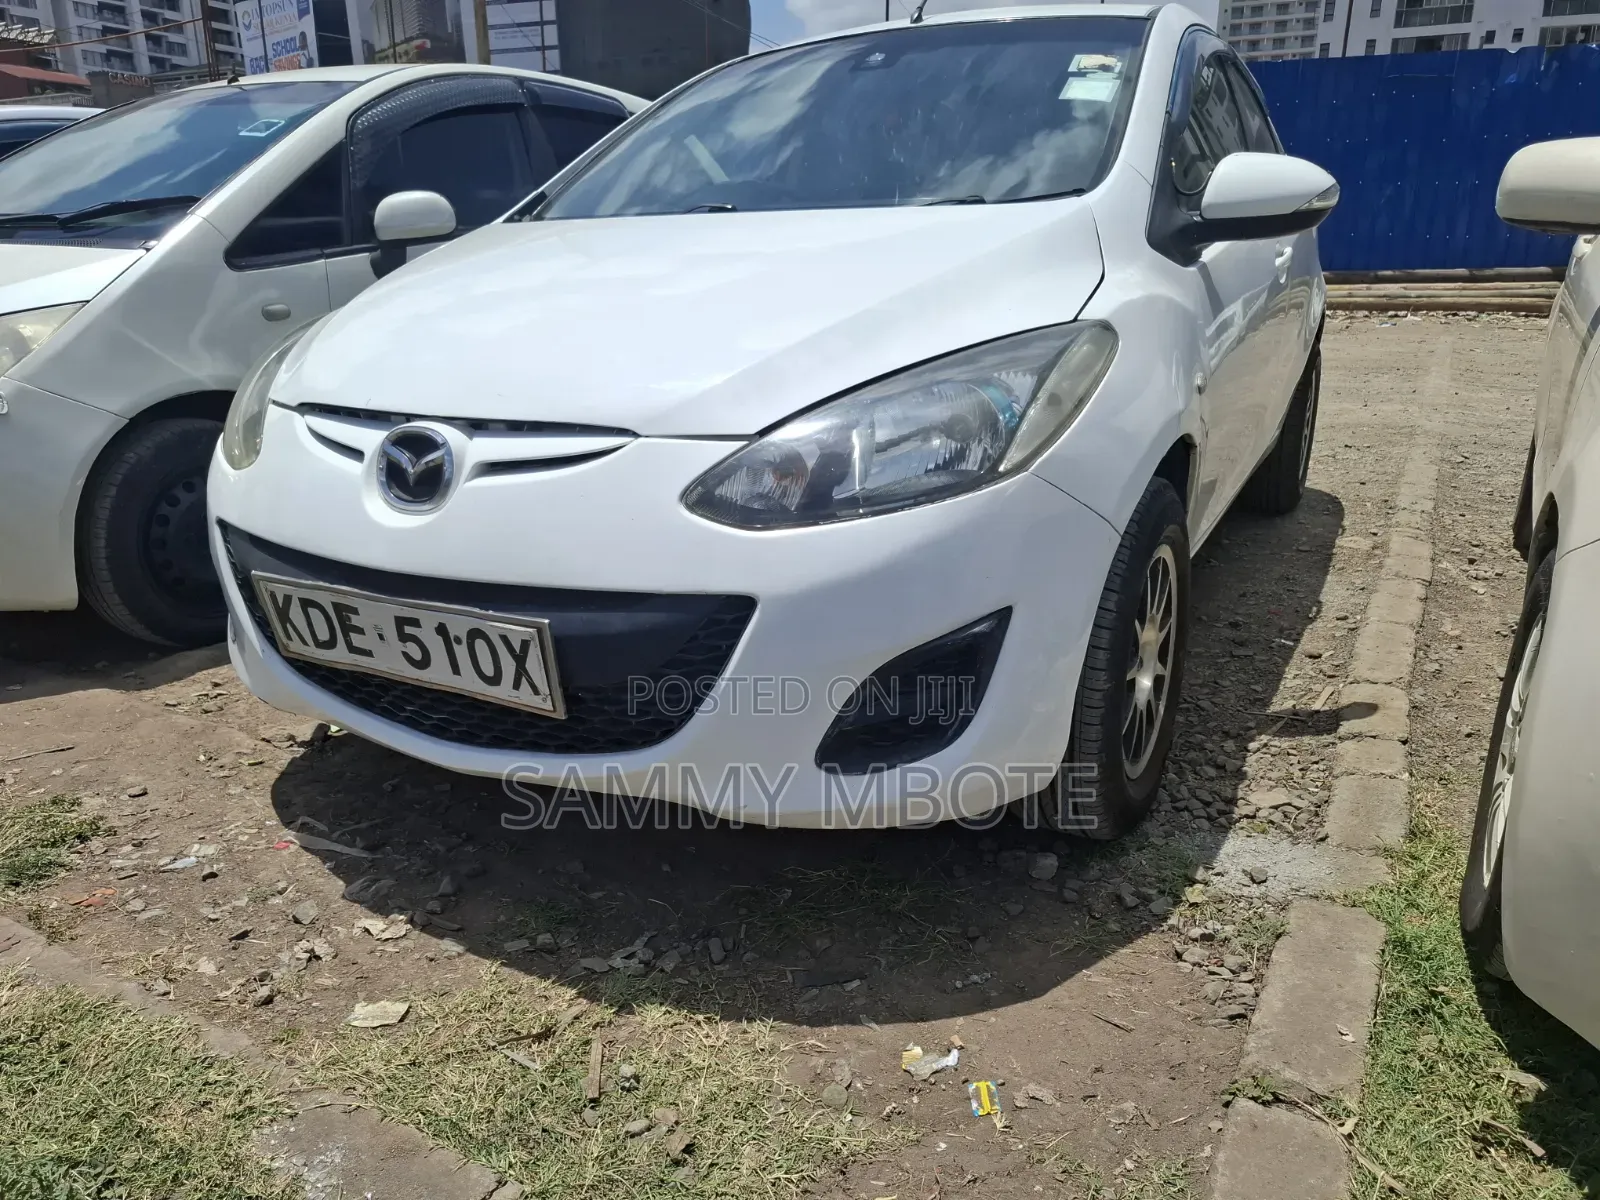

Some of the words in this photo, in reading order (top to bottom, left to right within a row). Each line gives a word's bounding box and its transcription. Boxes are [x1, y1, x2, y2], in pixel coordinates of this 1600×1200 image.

[271, 35, 300, 60] SCHOOL
[108, 71, 151, 88] CASINO
[269, 590, 375, 659] KDE
[394, 616, 542, 696] 510X
